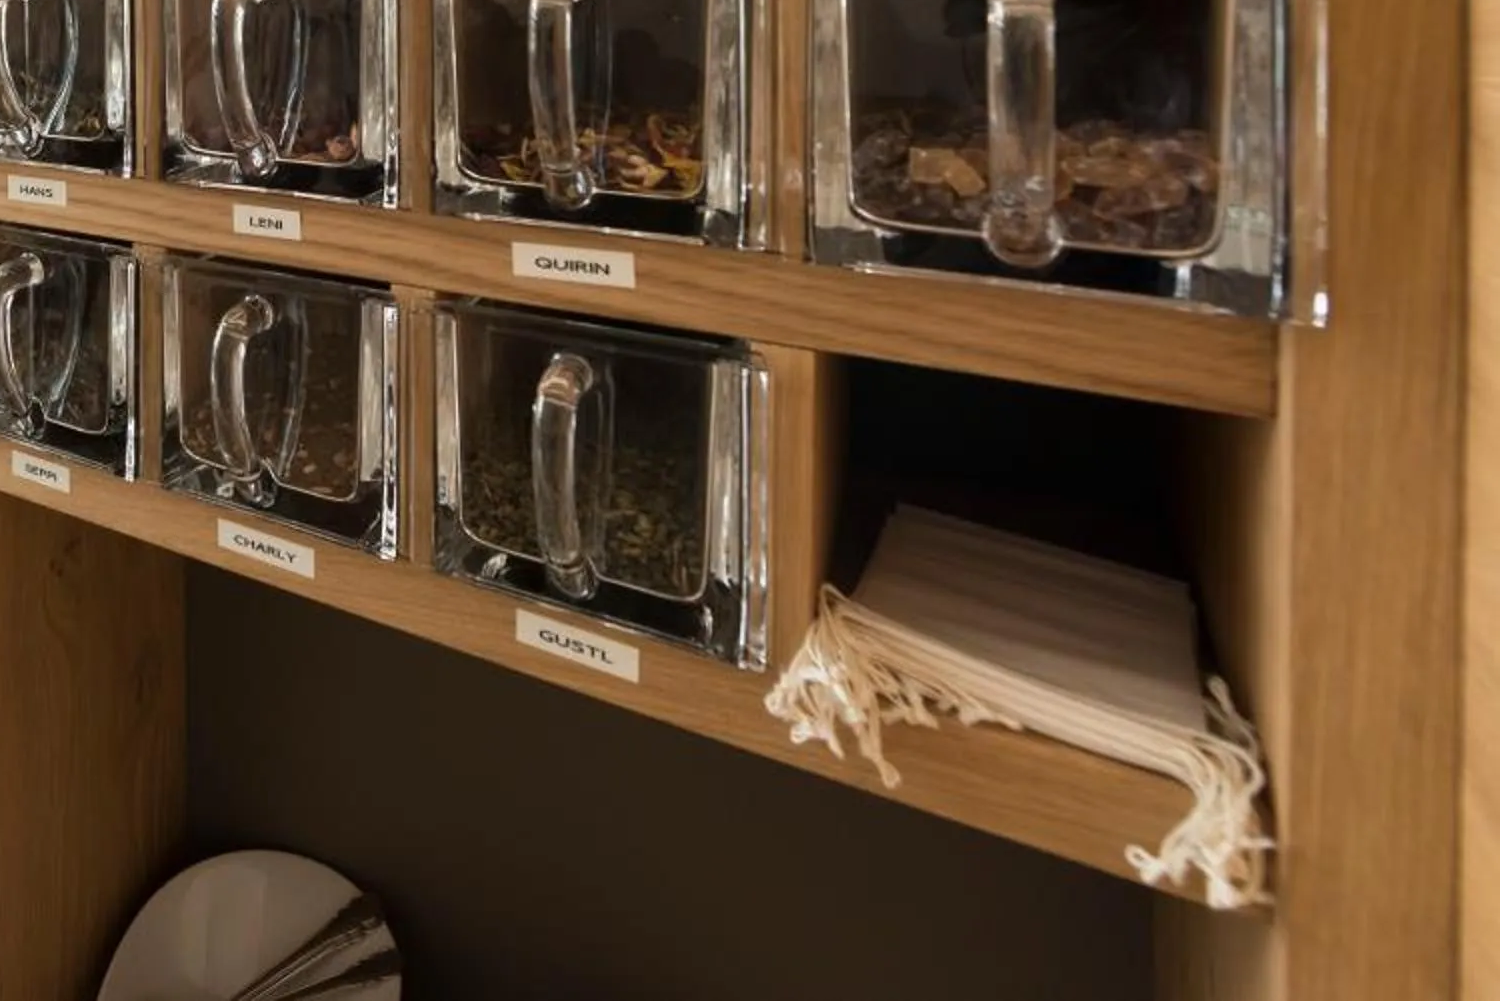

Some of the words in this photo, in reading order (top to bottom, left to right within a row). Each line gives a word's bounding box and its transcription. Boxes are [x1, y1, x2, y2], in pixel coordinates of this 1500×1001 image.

[19, 185, 53, 199] HANS
[249, 216, 283, 230] LENI
[534, 256, 611, 276] QUIRIN
[25, 462, 58, 481] SEPPI
[234, 534, 298, 565] CHARLY
[540, 630, 613, 665] GUSTL
